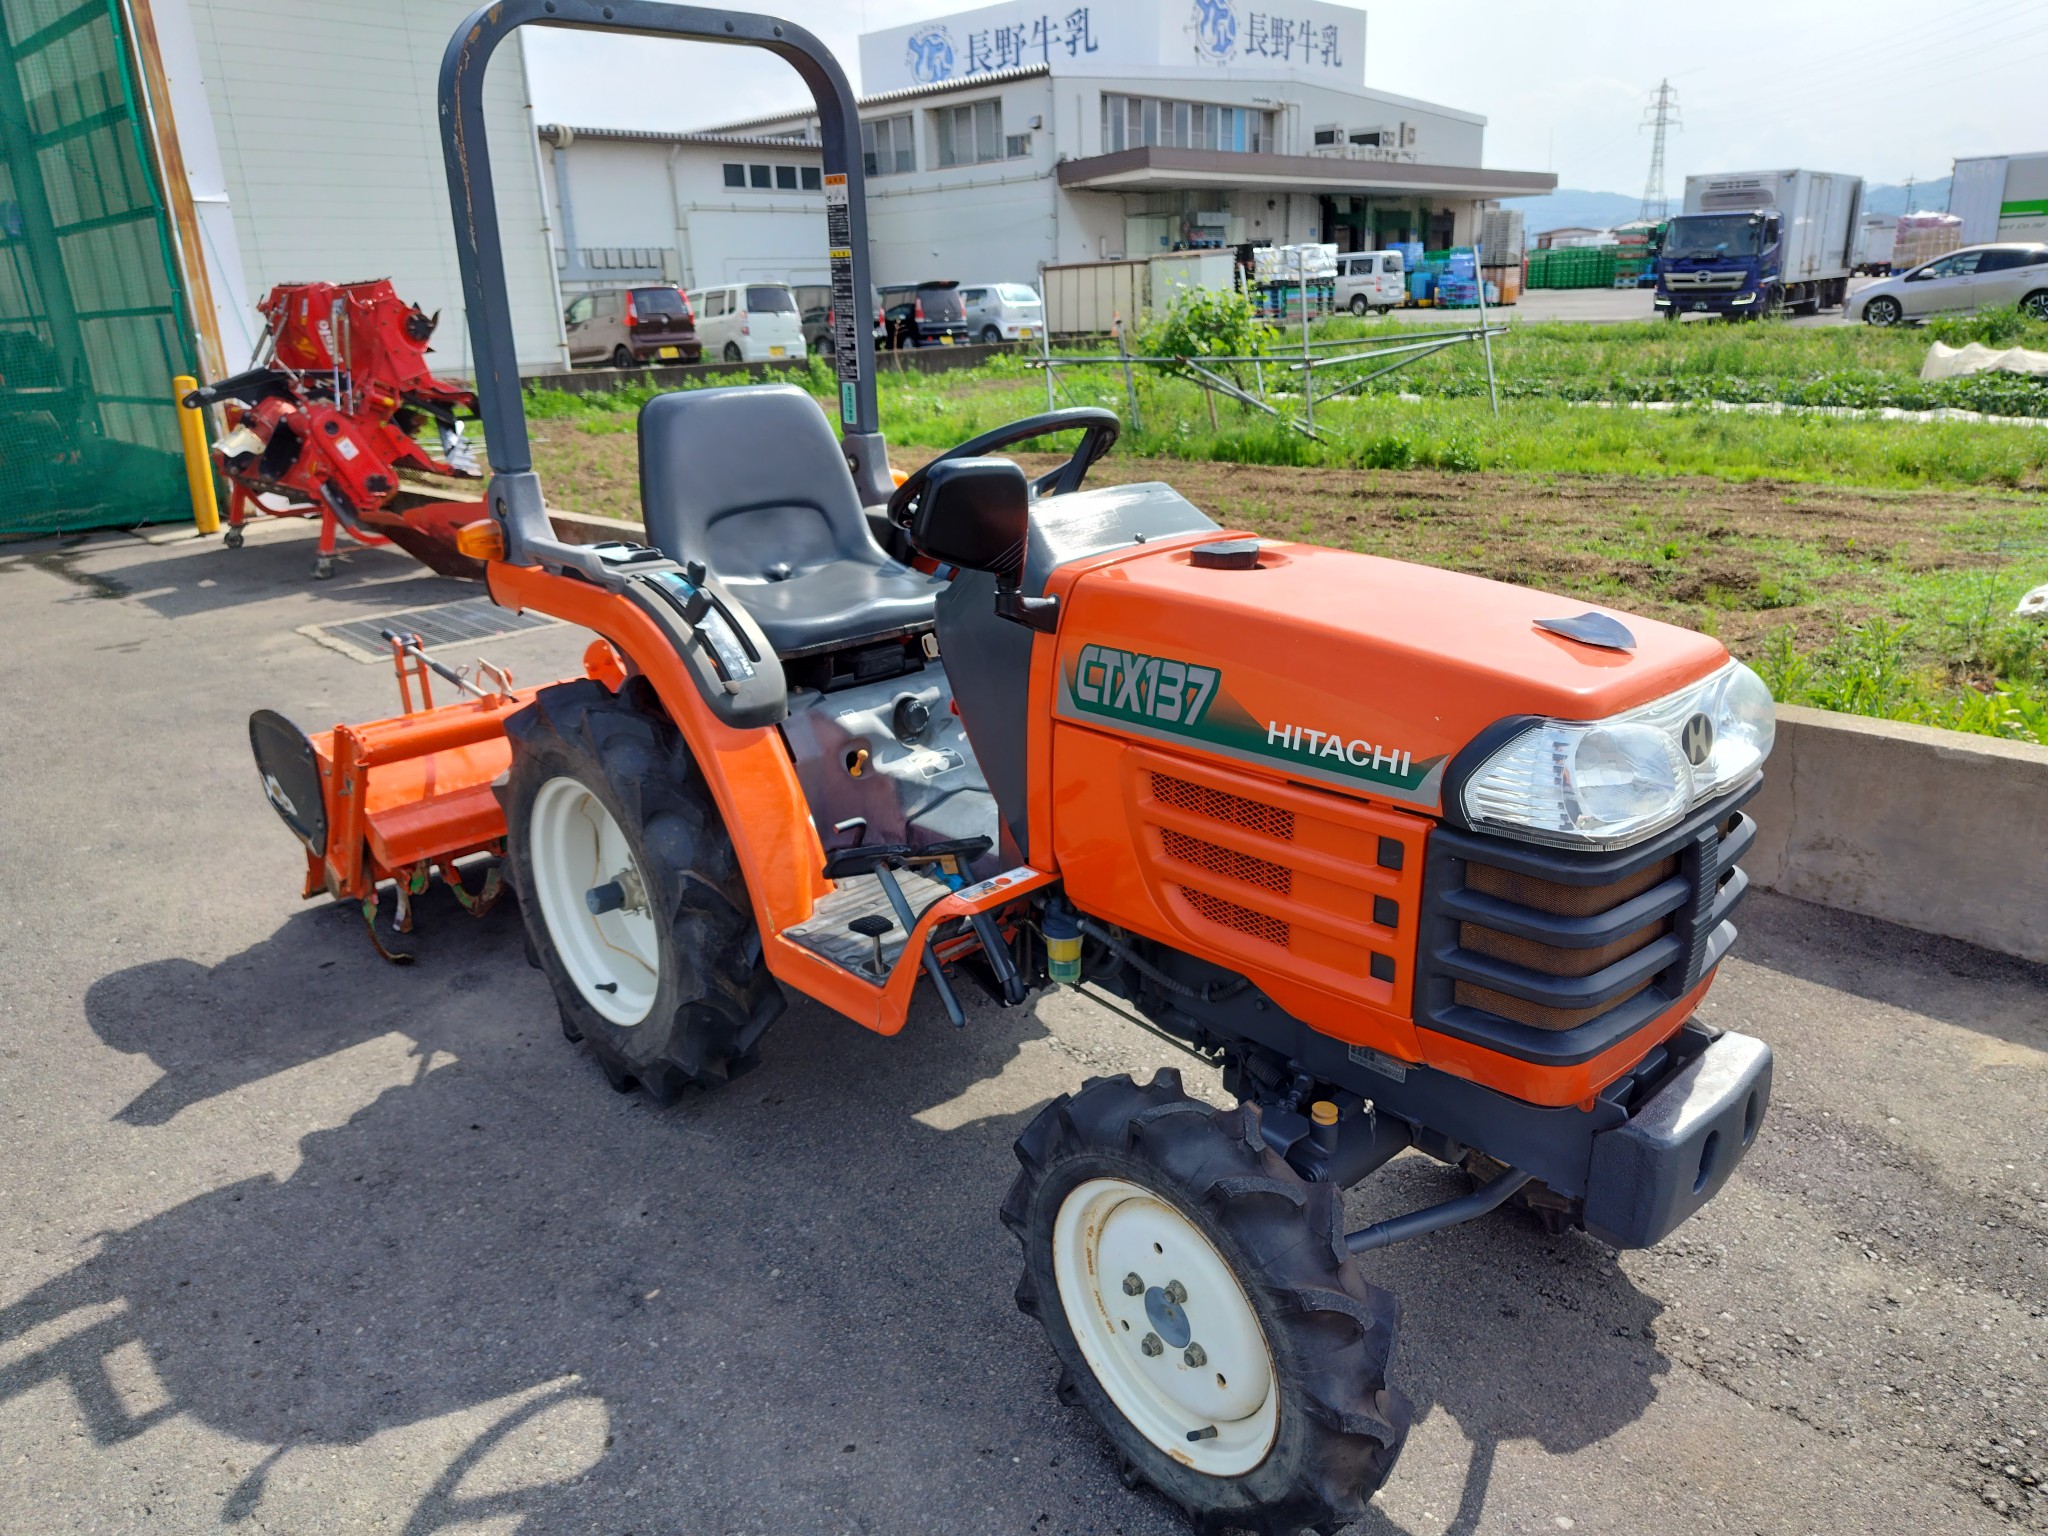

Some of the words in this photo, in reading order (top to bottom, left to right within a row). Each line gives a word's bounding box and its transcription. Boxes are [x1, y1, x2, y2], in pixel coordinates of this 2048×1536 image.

[963, 7, 1099, 76] 長野牛乳
[1244, 12, 1343, 67] 長野牛乳
[1075, 645, 1217, 726] CTX137
[1267, 721, 1412, 778] HITACHI
